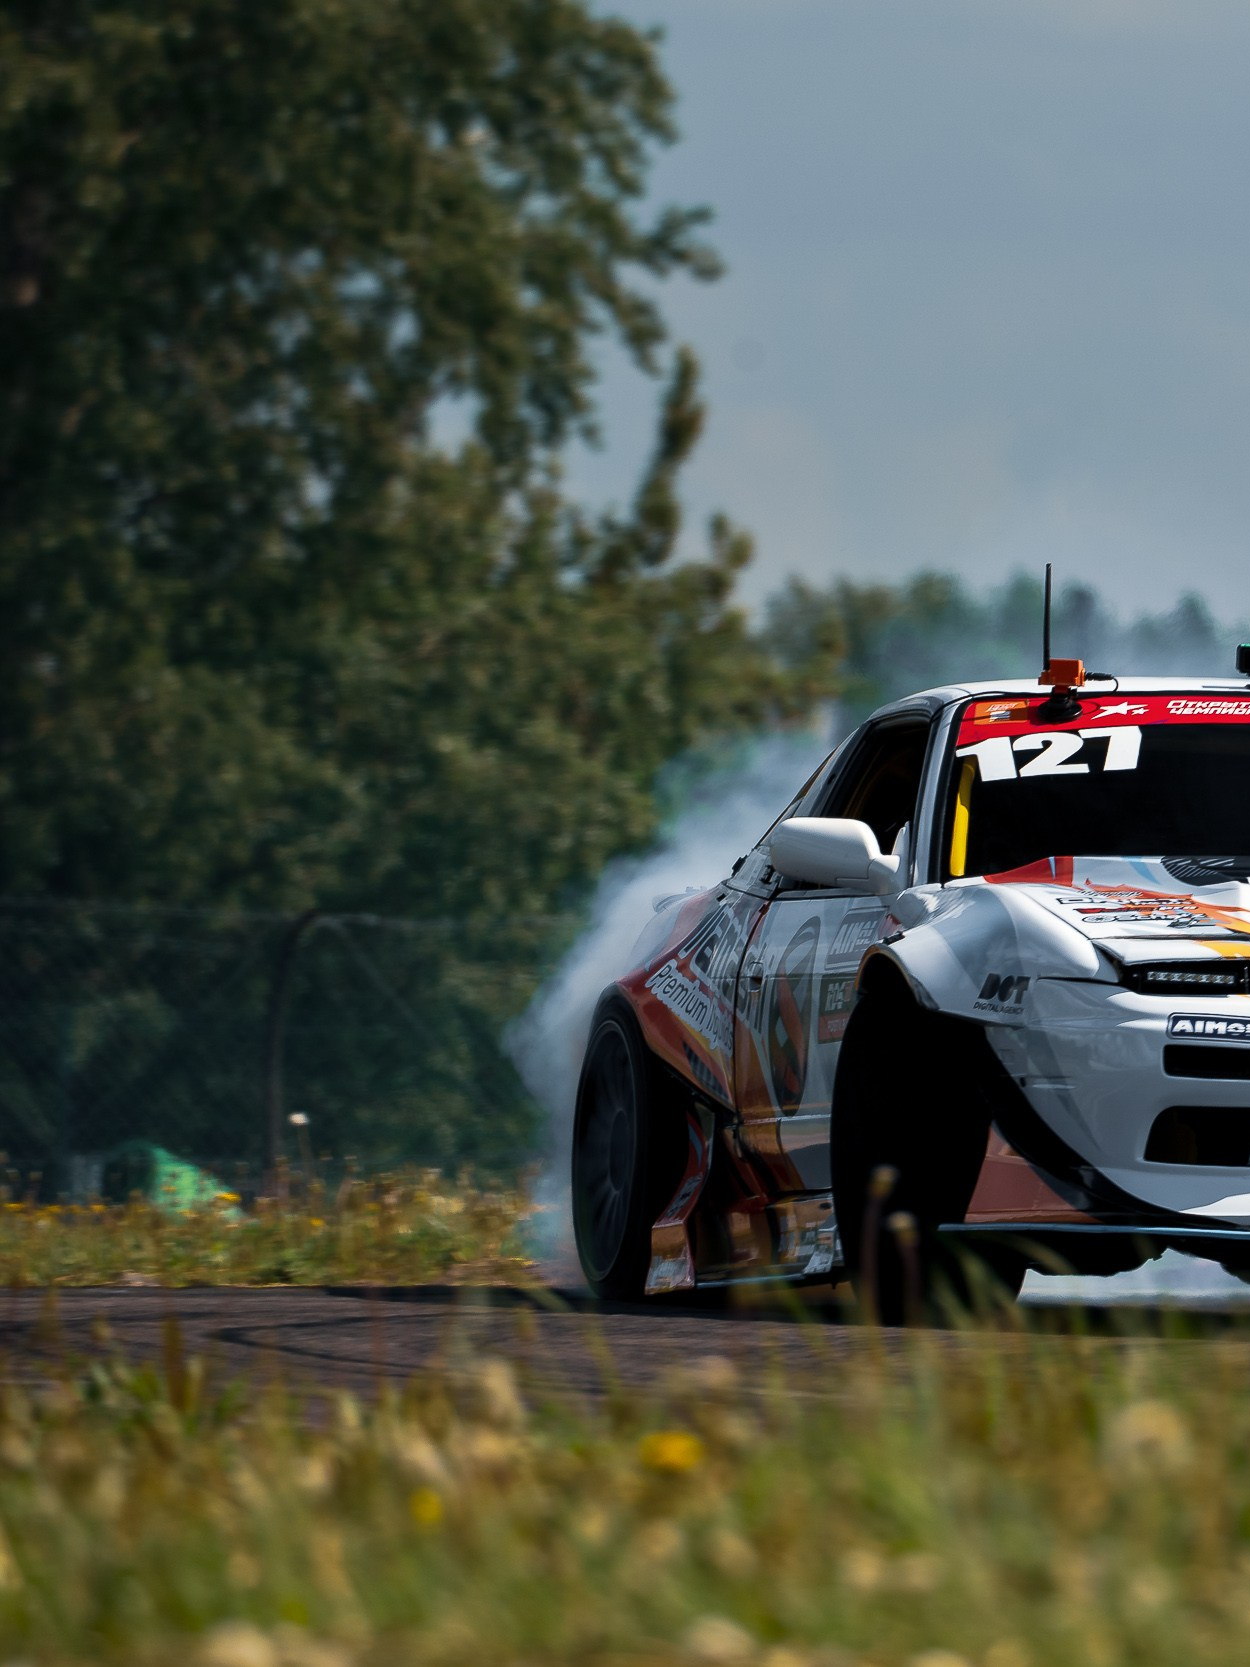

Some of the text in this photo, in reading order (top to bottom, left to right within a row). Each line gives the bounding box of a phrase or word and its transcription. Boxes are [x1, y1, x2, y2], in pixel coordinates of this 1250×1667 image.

[956, 726, 1143, 782] 127
[650, 964, 709, 1029] Premium
[972, 1001, 1000, 1013] DIGITAL
